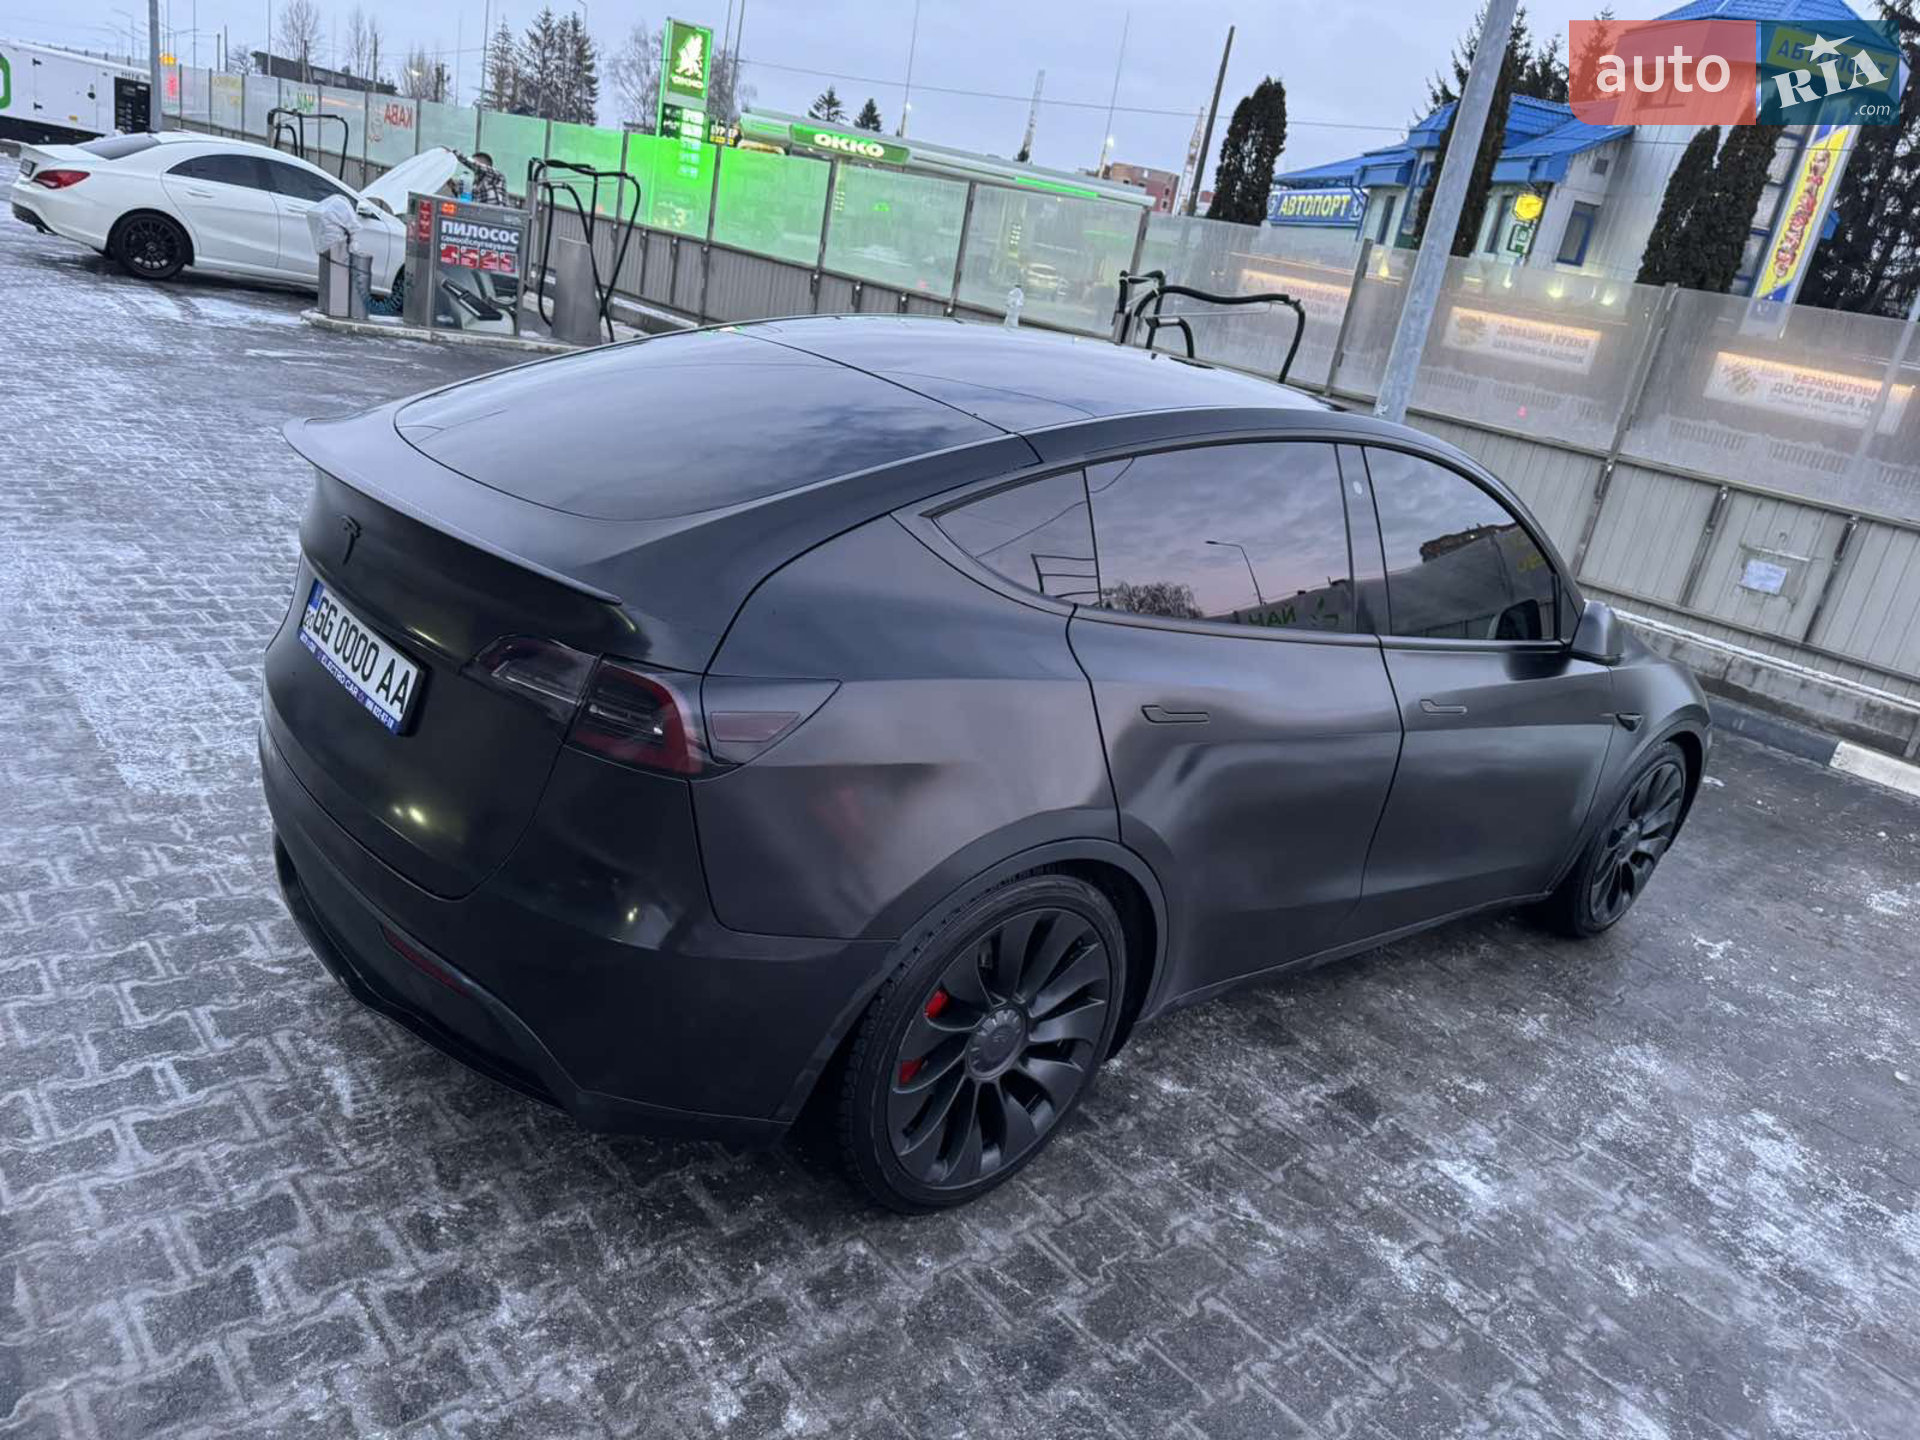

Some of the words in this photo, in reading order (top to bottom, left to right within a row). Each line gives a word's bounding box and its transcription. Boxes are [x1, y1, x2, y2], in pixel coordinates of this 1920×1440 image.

[1278, 194, 1351, 217] АВТОПОРТ
[441, 220, 519, 244] ПИЛОСОС
[1772, 382, 1854, 407] ДОСТАВКА
[1792, 373, 1883, 396] БЕЗКОШТОВН
[313, 596, 338, 644] GG
[333, 615, 380, 683] 0000
[375, 658, 410, 714] AA
[321, 654, 346, 686] ELECTRO
[344, 679, 359, 698] CAR
